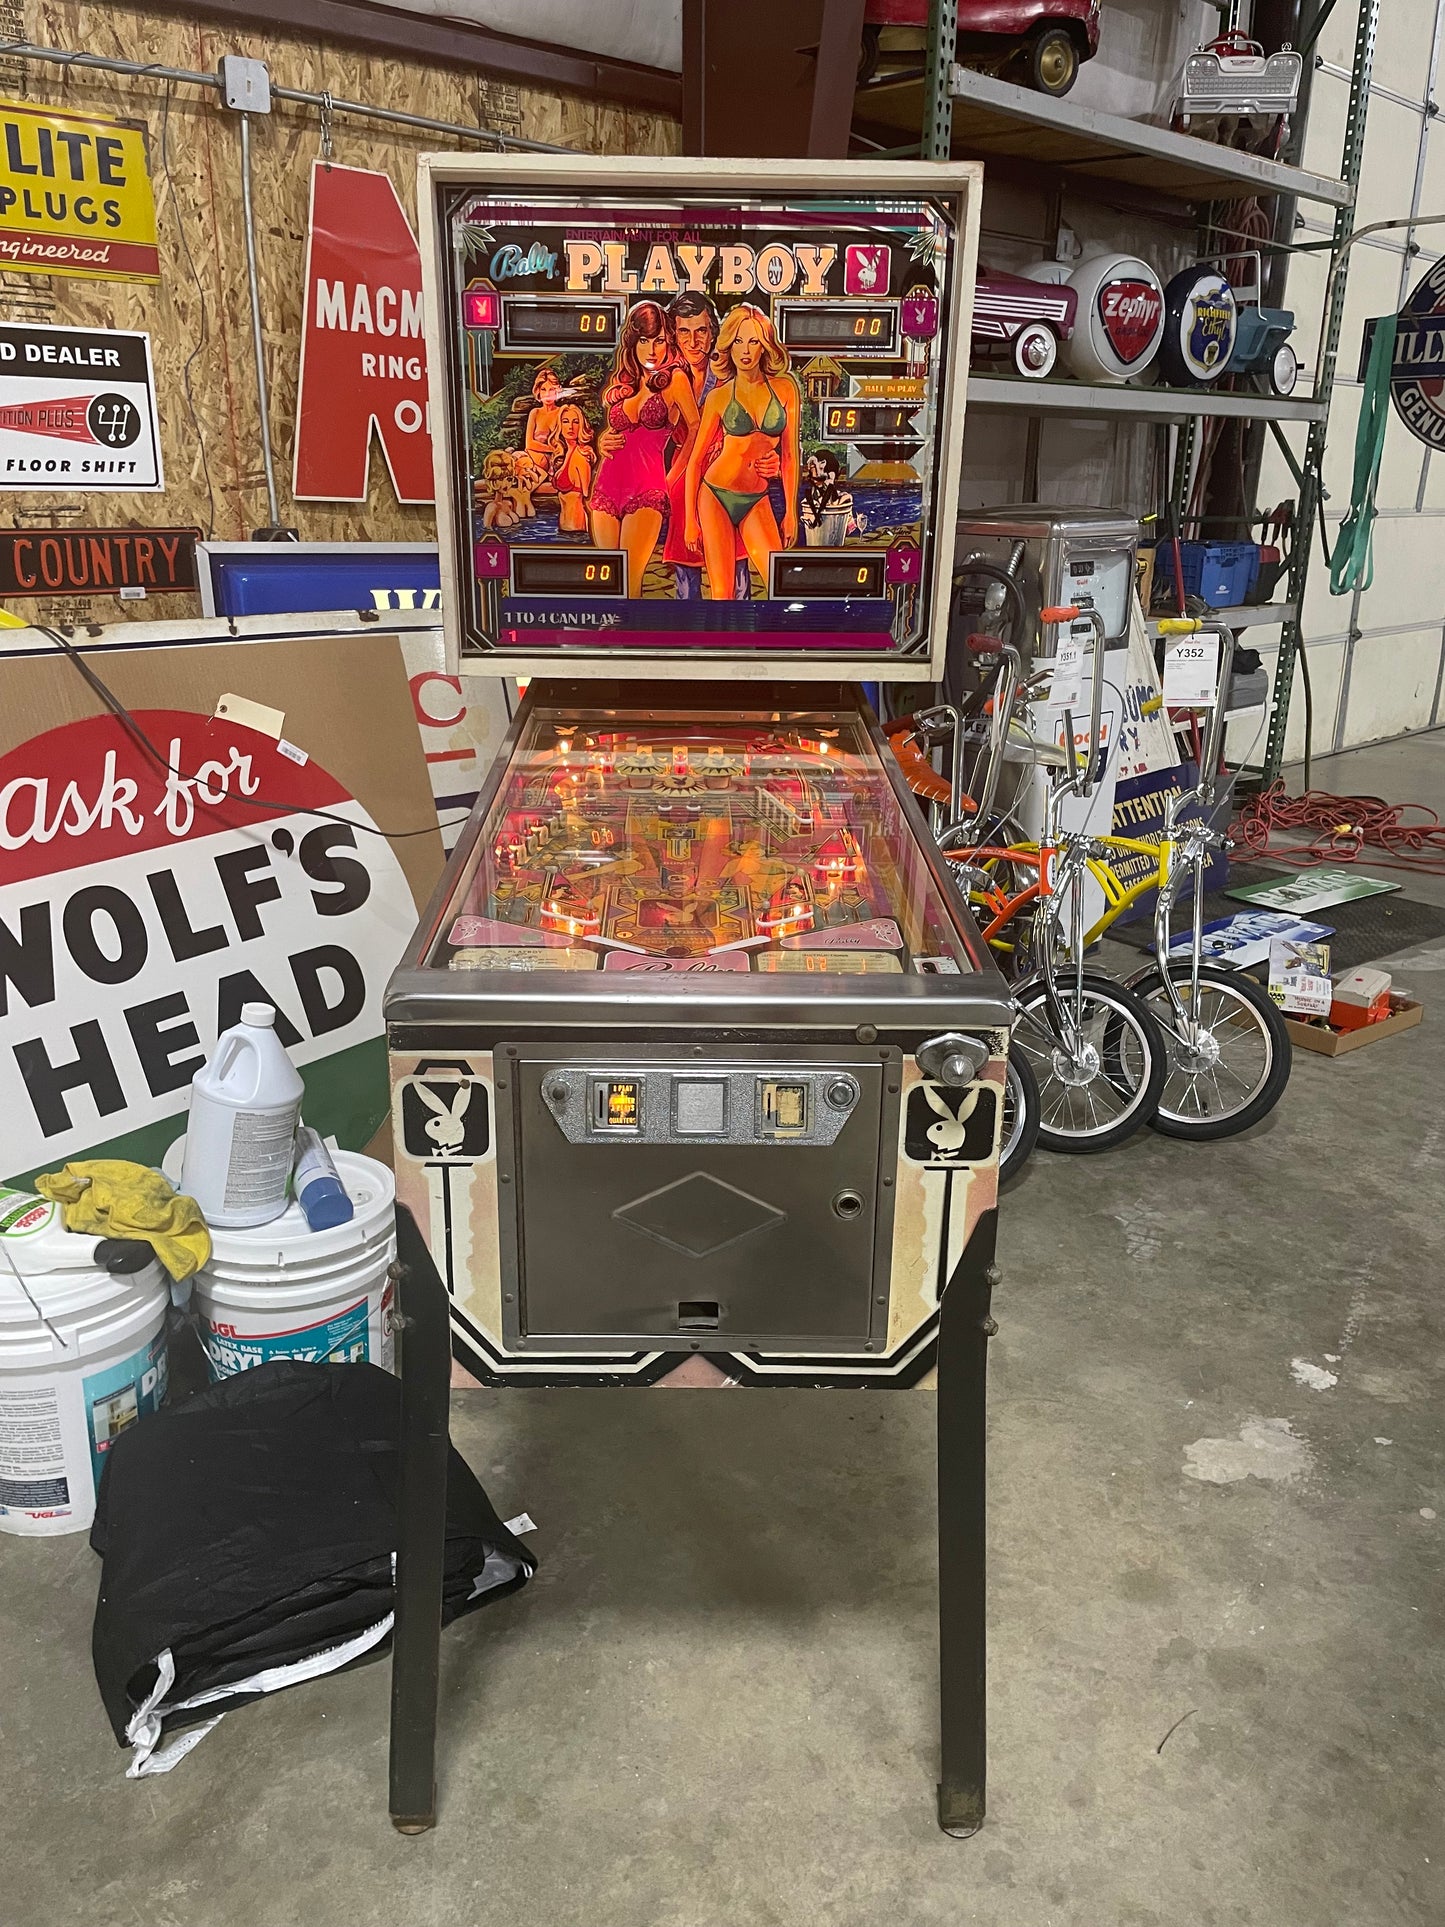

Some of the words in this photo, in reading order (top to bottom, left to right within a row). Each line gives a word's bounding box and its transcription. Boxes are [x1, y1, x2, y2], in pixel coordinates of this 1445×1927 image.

[4, 122, 127, 187] LITE
[0, 186, 122, 228] PLUGS
[657, 231, 678, 242] FOR
[683, 231, 701, 242] ALL
[490, 241, 560, 282] Bally
[564, 240, 837, 295] PLAYBOY
[1105, 291, 1160, 327] Zephyr
[579, 314, 607, 332] 00
[853, 317, 881, 336] 00
[1201, 317, 1227, 341] Ethyl
[24, 343, 121, 367] DEALER
[865, 385, 883, 393] BALL
[897, 385, 917, 394] PLAY
[37, 409, 75, 429] PLUS
[830, 410, 857, 428] 05
[895, 412, 902, 427] 1
[6, 459, 71, 472] FLOOR
[81, 461, 137, 473] SHIFT
[13, 536, 180, 588] COUNTRY
[585, 565, 610, 581] 00
[857, 567, 868, 583] 0
[515, 612, 535, 624] TO
[537, 613, 547, 624] 4
[549, 612, 579, 624] CAN
[581, 613, 619, 625] PLAY
[508, 630, 517, 642] 1
[1176, 648, 1204, 658] Y352
[0, 750, 144, 850] ask
[153, 737, 260, 837] for
[12, 944, 366, 1138] HEAD
[209, 1320, 237, 1338] UGL
[217, 1337, 237, 1350] LATEX
[240, 1345, 263, 1354] BASE
